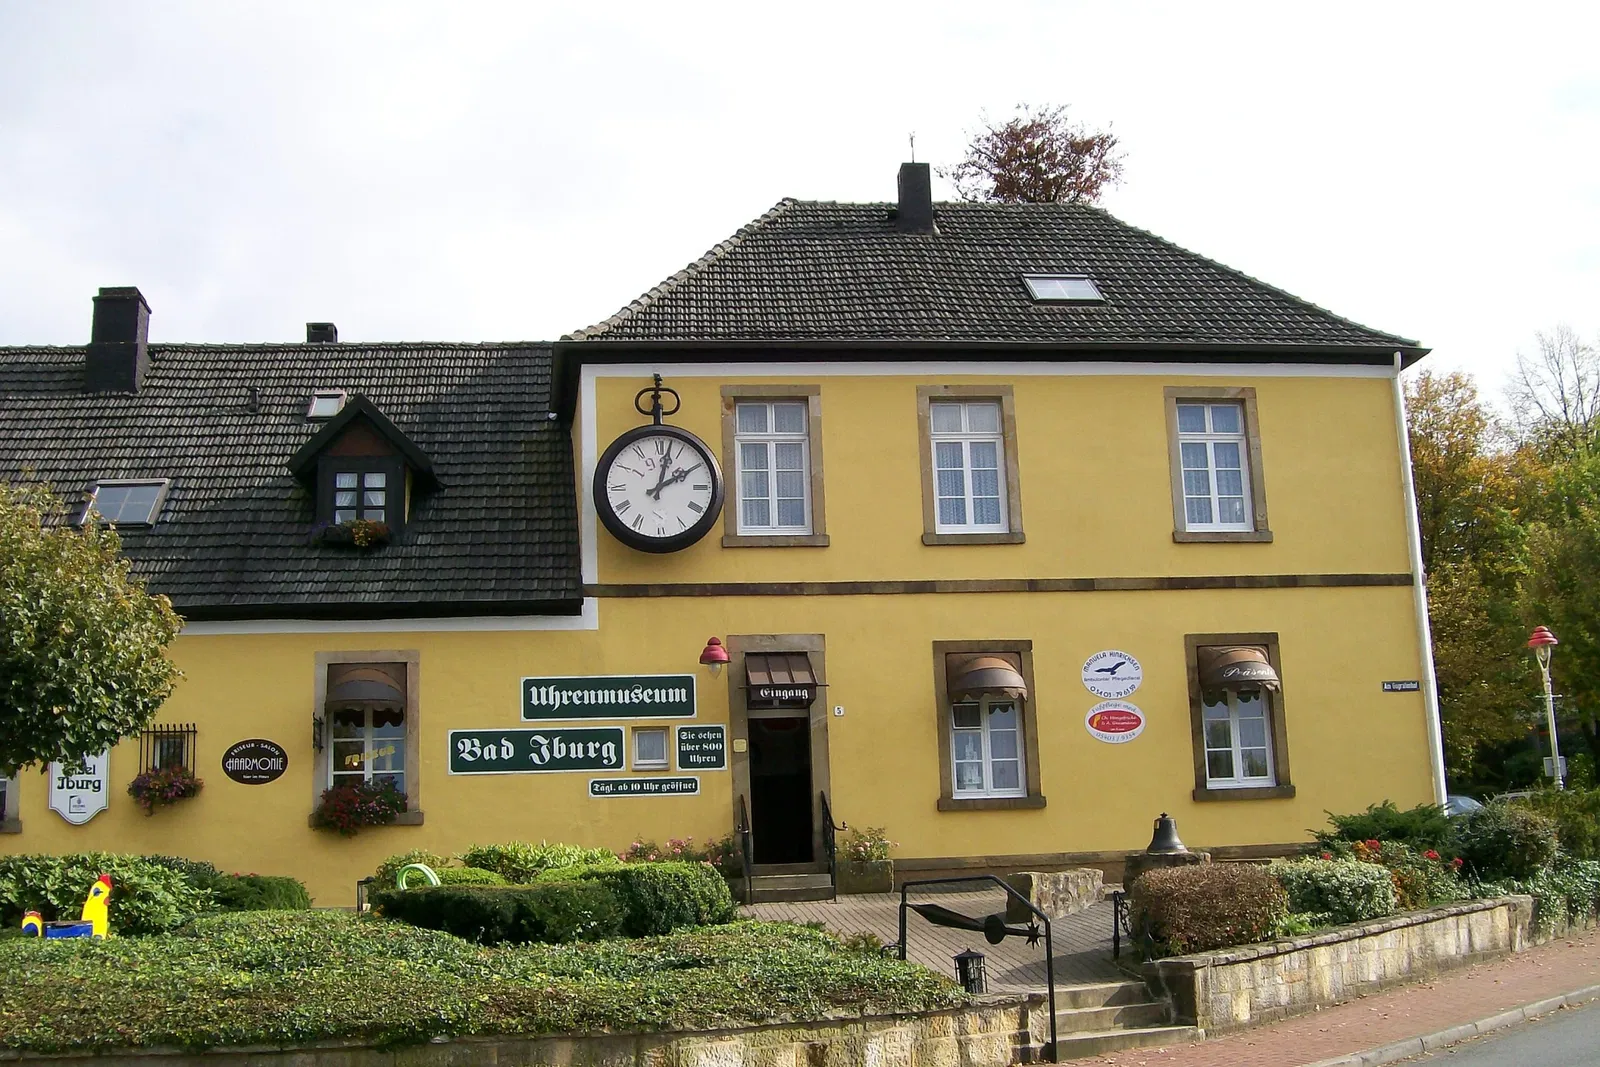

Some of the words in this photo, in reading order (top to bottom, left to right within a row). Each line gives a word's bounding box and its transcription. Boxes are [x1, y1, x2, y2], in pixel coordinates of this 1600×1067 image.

[1083, 652, 1107, 673] MANUELA
[529, 684, 688, 712] Uhrenmuseum
[759, 688, 809, 700] Eingang
[836, 707, 842, 715] 5
[680, 731, 696, 740] Sie
[230, 742, 255, 756] FRISEUR
[260, 743, 280, 756] SALON
[457, 736, 515, 763] Bad
[680, 742, 701, 752] über
[702, 742, 723, 751] 800
[225, 757, 284, 772] HAARMONIE
[689, 754, 717, 764] Uhren
[592, 783, 616, 793] Tägl.
[617, 783, 628, 791] ab
[631, 782, 640, 791] 10
[643, 782, 660, 792] Uhr
[661, 781, 696, 792] geöffnet
